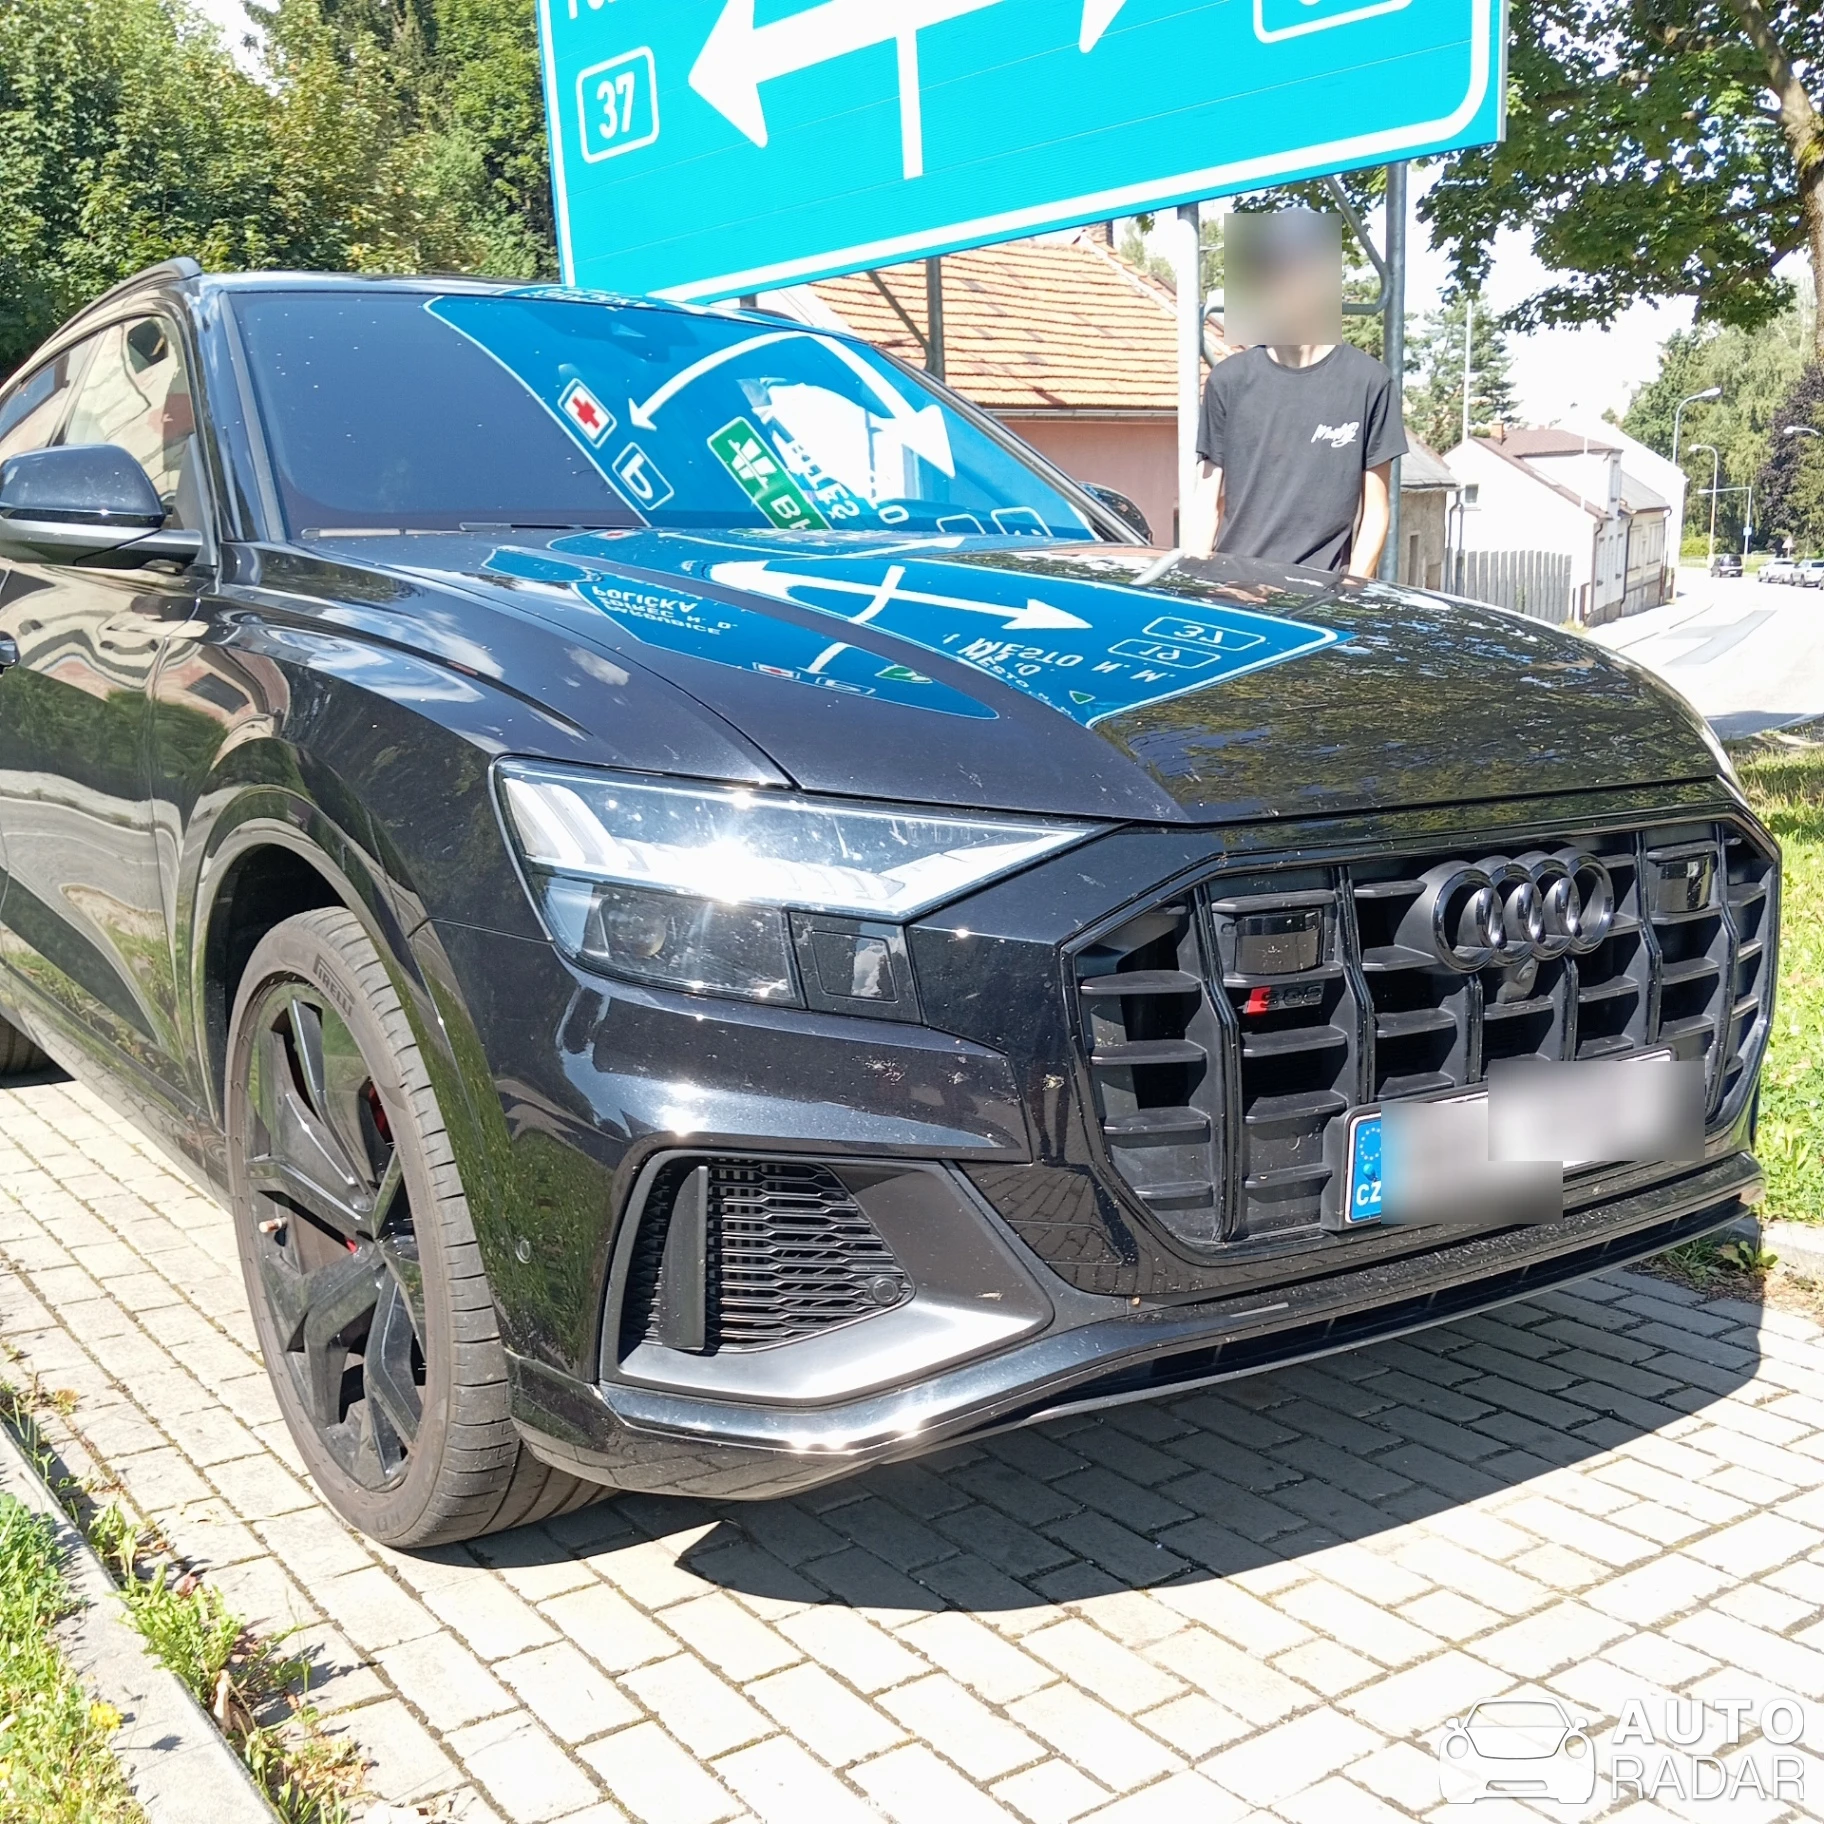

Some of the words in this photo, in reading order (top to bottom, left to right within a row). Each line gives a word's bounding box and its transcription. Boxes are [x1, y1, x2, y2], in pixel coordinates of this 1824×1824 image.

[597, 71, 635, 139] 37
[313, 953, 356, 1017] PIRELLI
[1356, 1180, 1382, 1206] CZ
